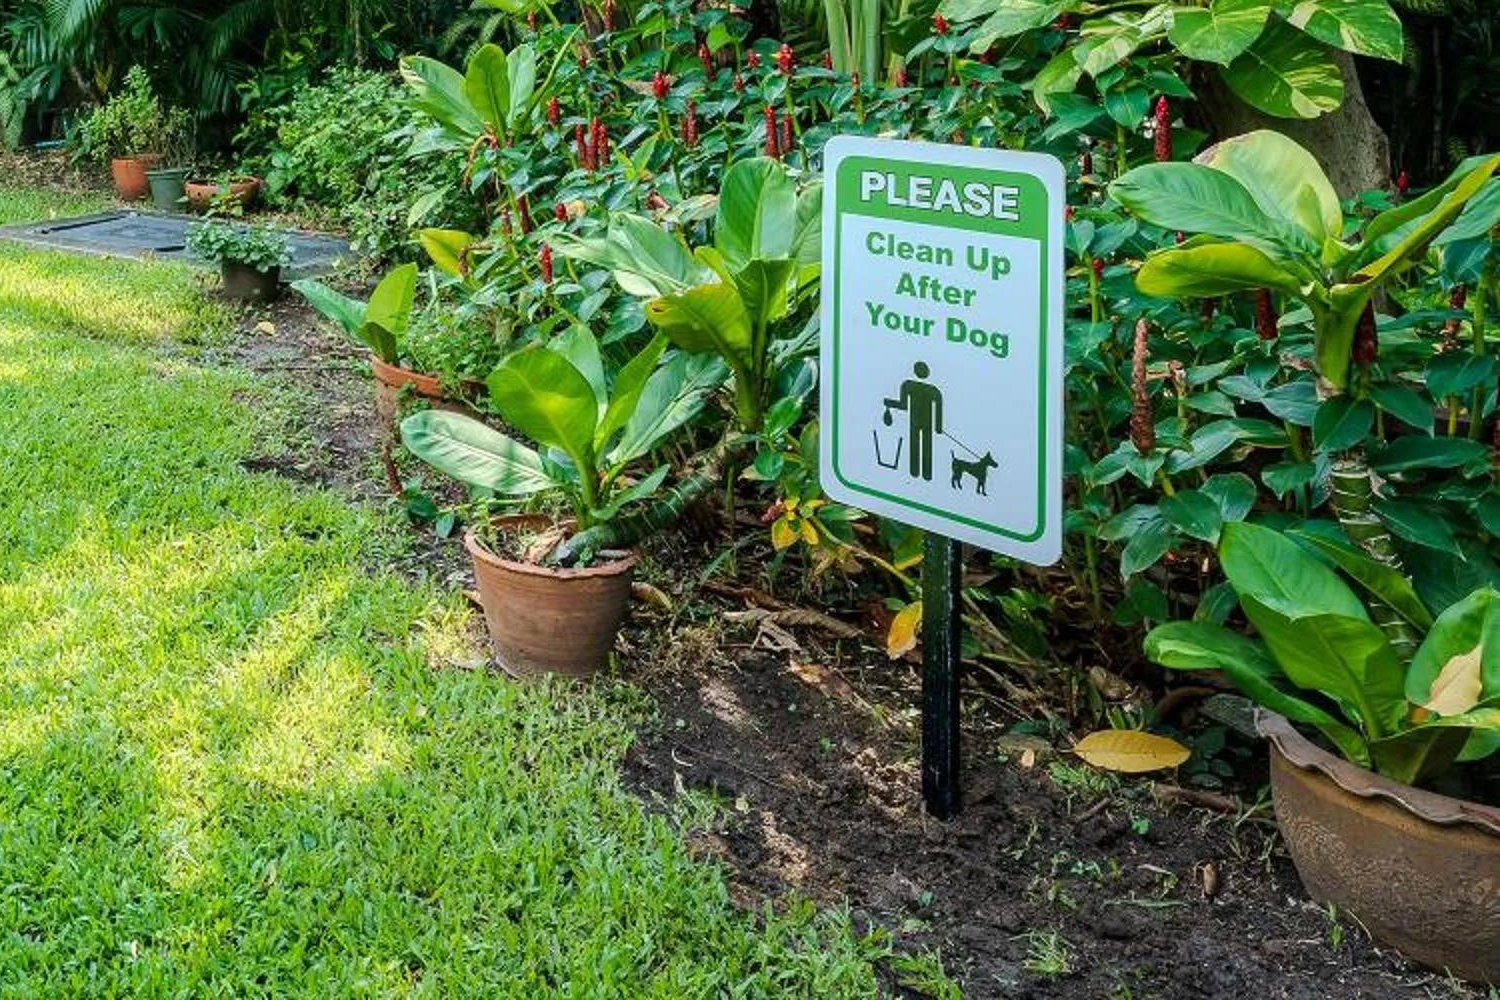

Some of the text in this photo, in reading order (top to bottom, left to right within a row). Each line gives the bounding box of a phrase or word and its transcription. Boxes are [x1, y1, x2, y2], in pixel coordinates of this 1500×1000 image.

[861, 171, 1020, 221] PLEASE
[866, 231, 1011, 280] Clean Up
[895, 272, 977, 307] After
[865, 301, 1009, 359] Your Dog
